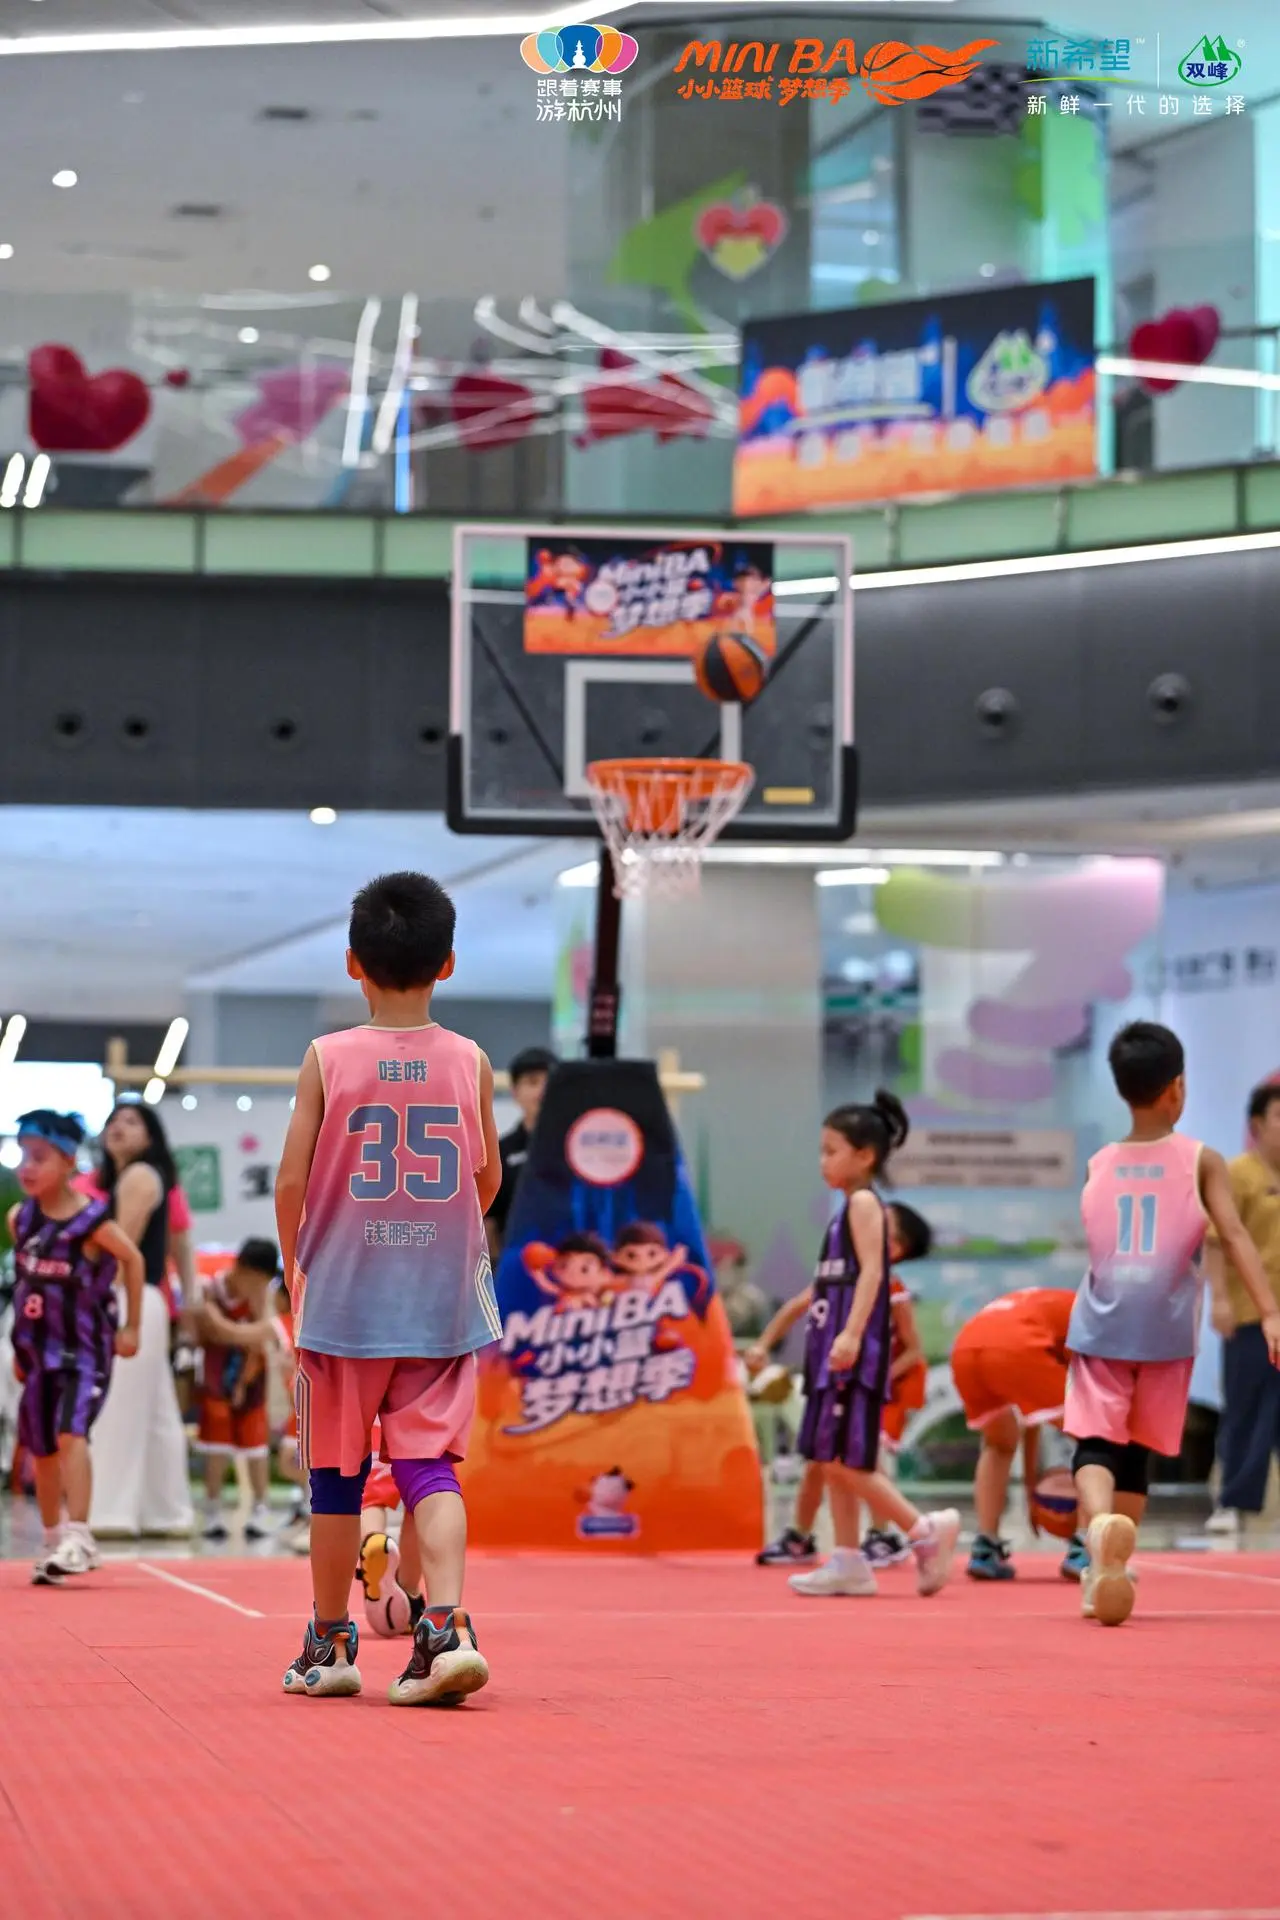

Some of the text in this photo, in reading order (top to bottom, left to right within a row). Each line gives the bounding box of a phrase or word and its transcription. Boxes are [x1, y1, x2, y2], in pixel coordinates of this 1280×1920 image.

[377, 1060, 428, 1083] 哇哦
[347, 1103, 461, 1203] 35
[365, 1220, 437, 1247] 钱鹏予
[1115, 1193, 1159, 1257] 11
[24, 1292, 43, 1319] 8
